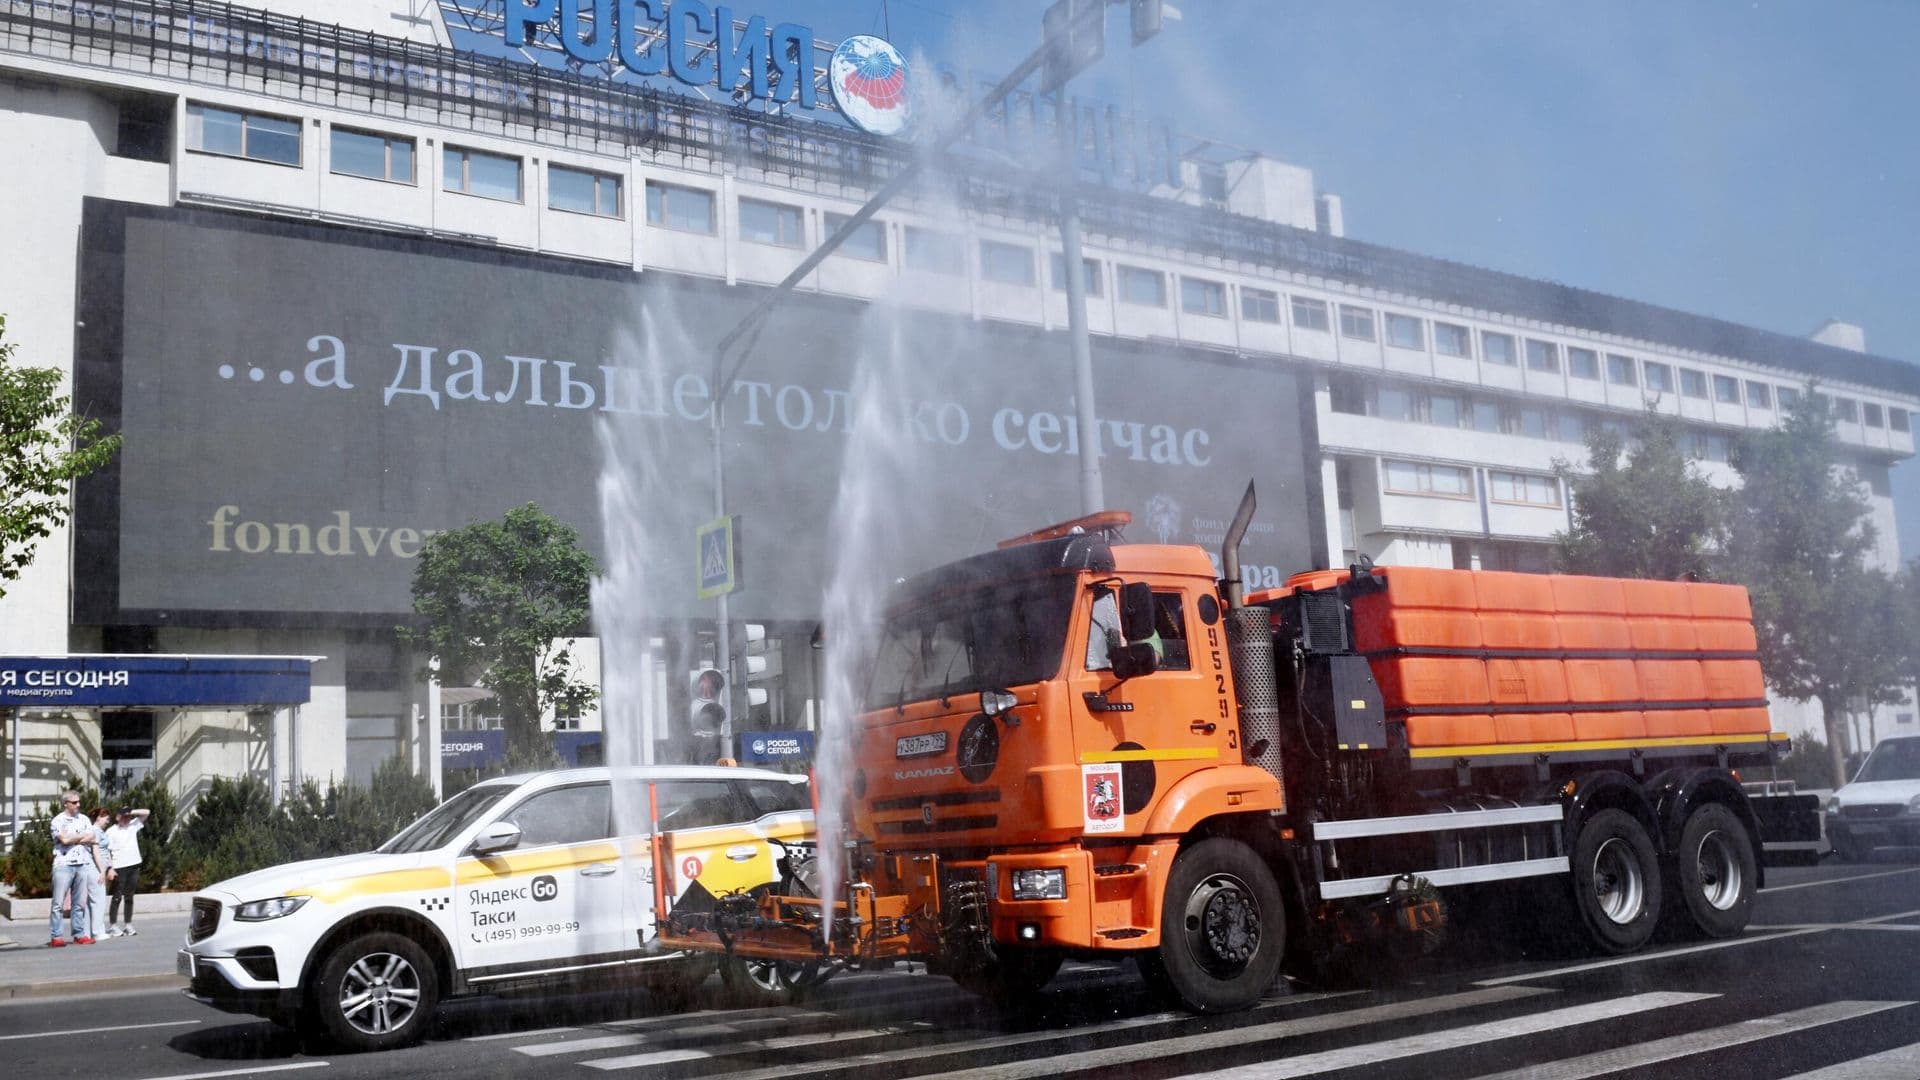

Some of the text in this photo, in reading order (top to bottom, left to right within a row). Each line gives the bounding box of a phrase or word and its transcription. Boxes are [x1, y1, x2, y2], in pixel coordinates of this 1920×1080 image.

[384, 343, 710, 421] дальше
[732, 379, 971, 446] толко
[207, 505, 447, 558] fondve
[25, 670, 129, 688] СЕГОДНЯ
[7, 688, 73, 697] медиагруппа
[767, 739, 798, 747] РОССИЯ
[767, 746, 800, 754] СЕГОДНЯ
[895, 766, 954, 781] KAMAZ
[470, 887, 527, 905] Яндекс
[533, 880, 556, 897] Go
[471, 911, 516, 926] Такси
[485, 921, 580, 943] (495) 999-99-99
